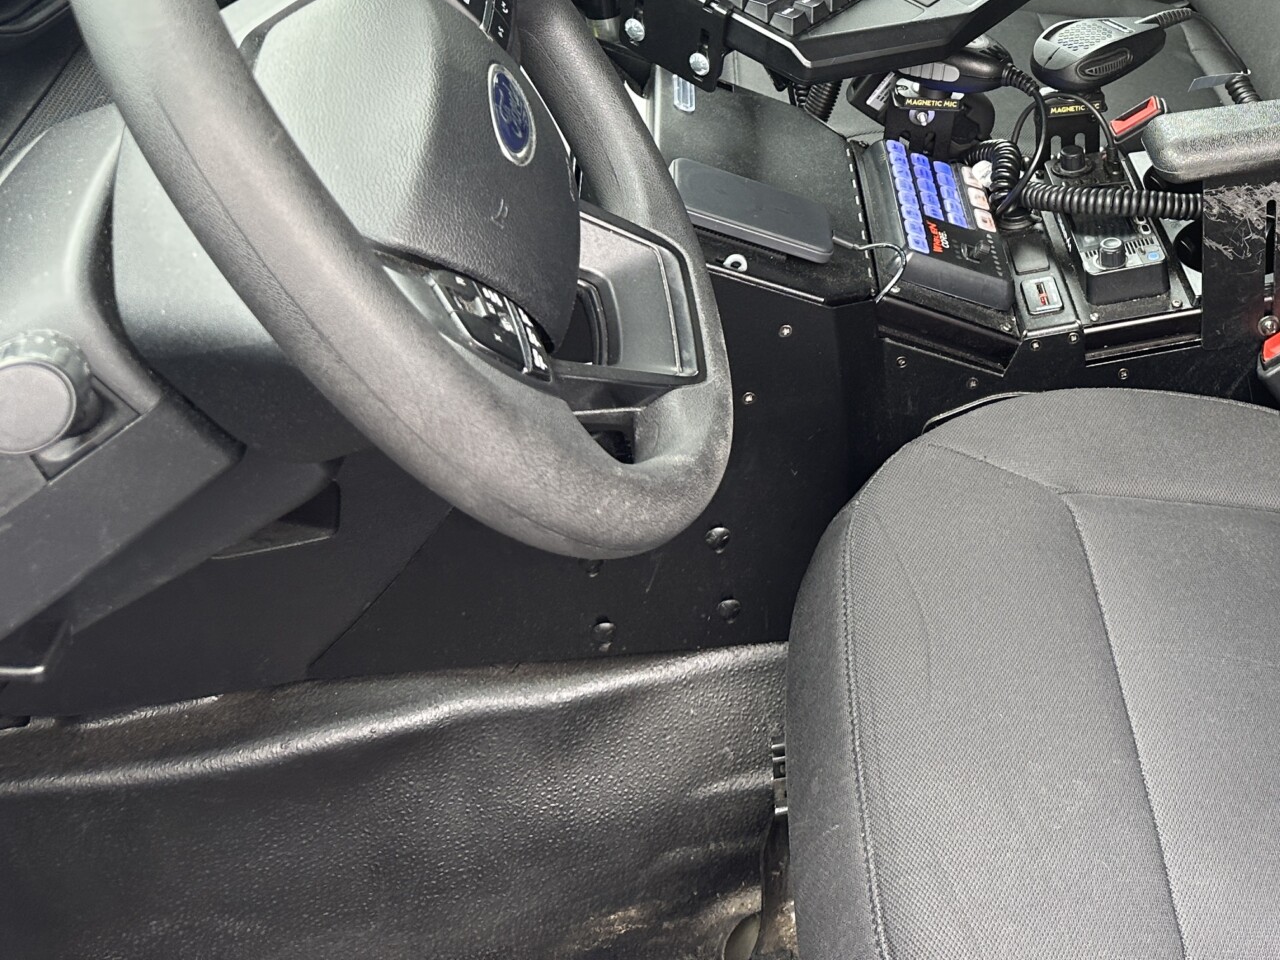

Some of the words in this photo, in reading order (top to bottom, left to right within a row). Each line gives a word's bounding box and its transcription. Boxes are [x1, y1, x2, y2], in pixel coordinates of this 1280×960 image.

[905, 99, 942, 107] MAGNETIC
[943, 100, 958, 108] MIC
[1050, 105, 1085, 114] MAGNETIC
